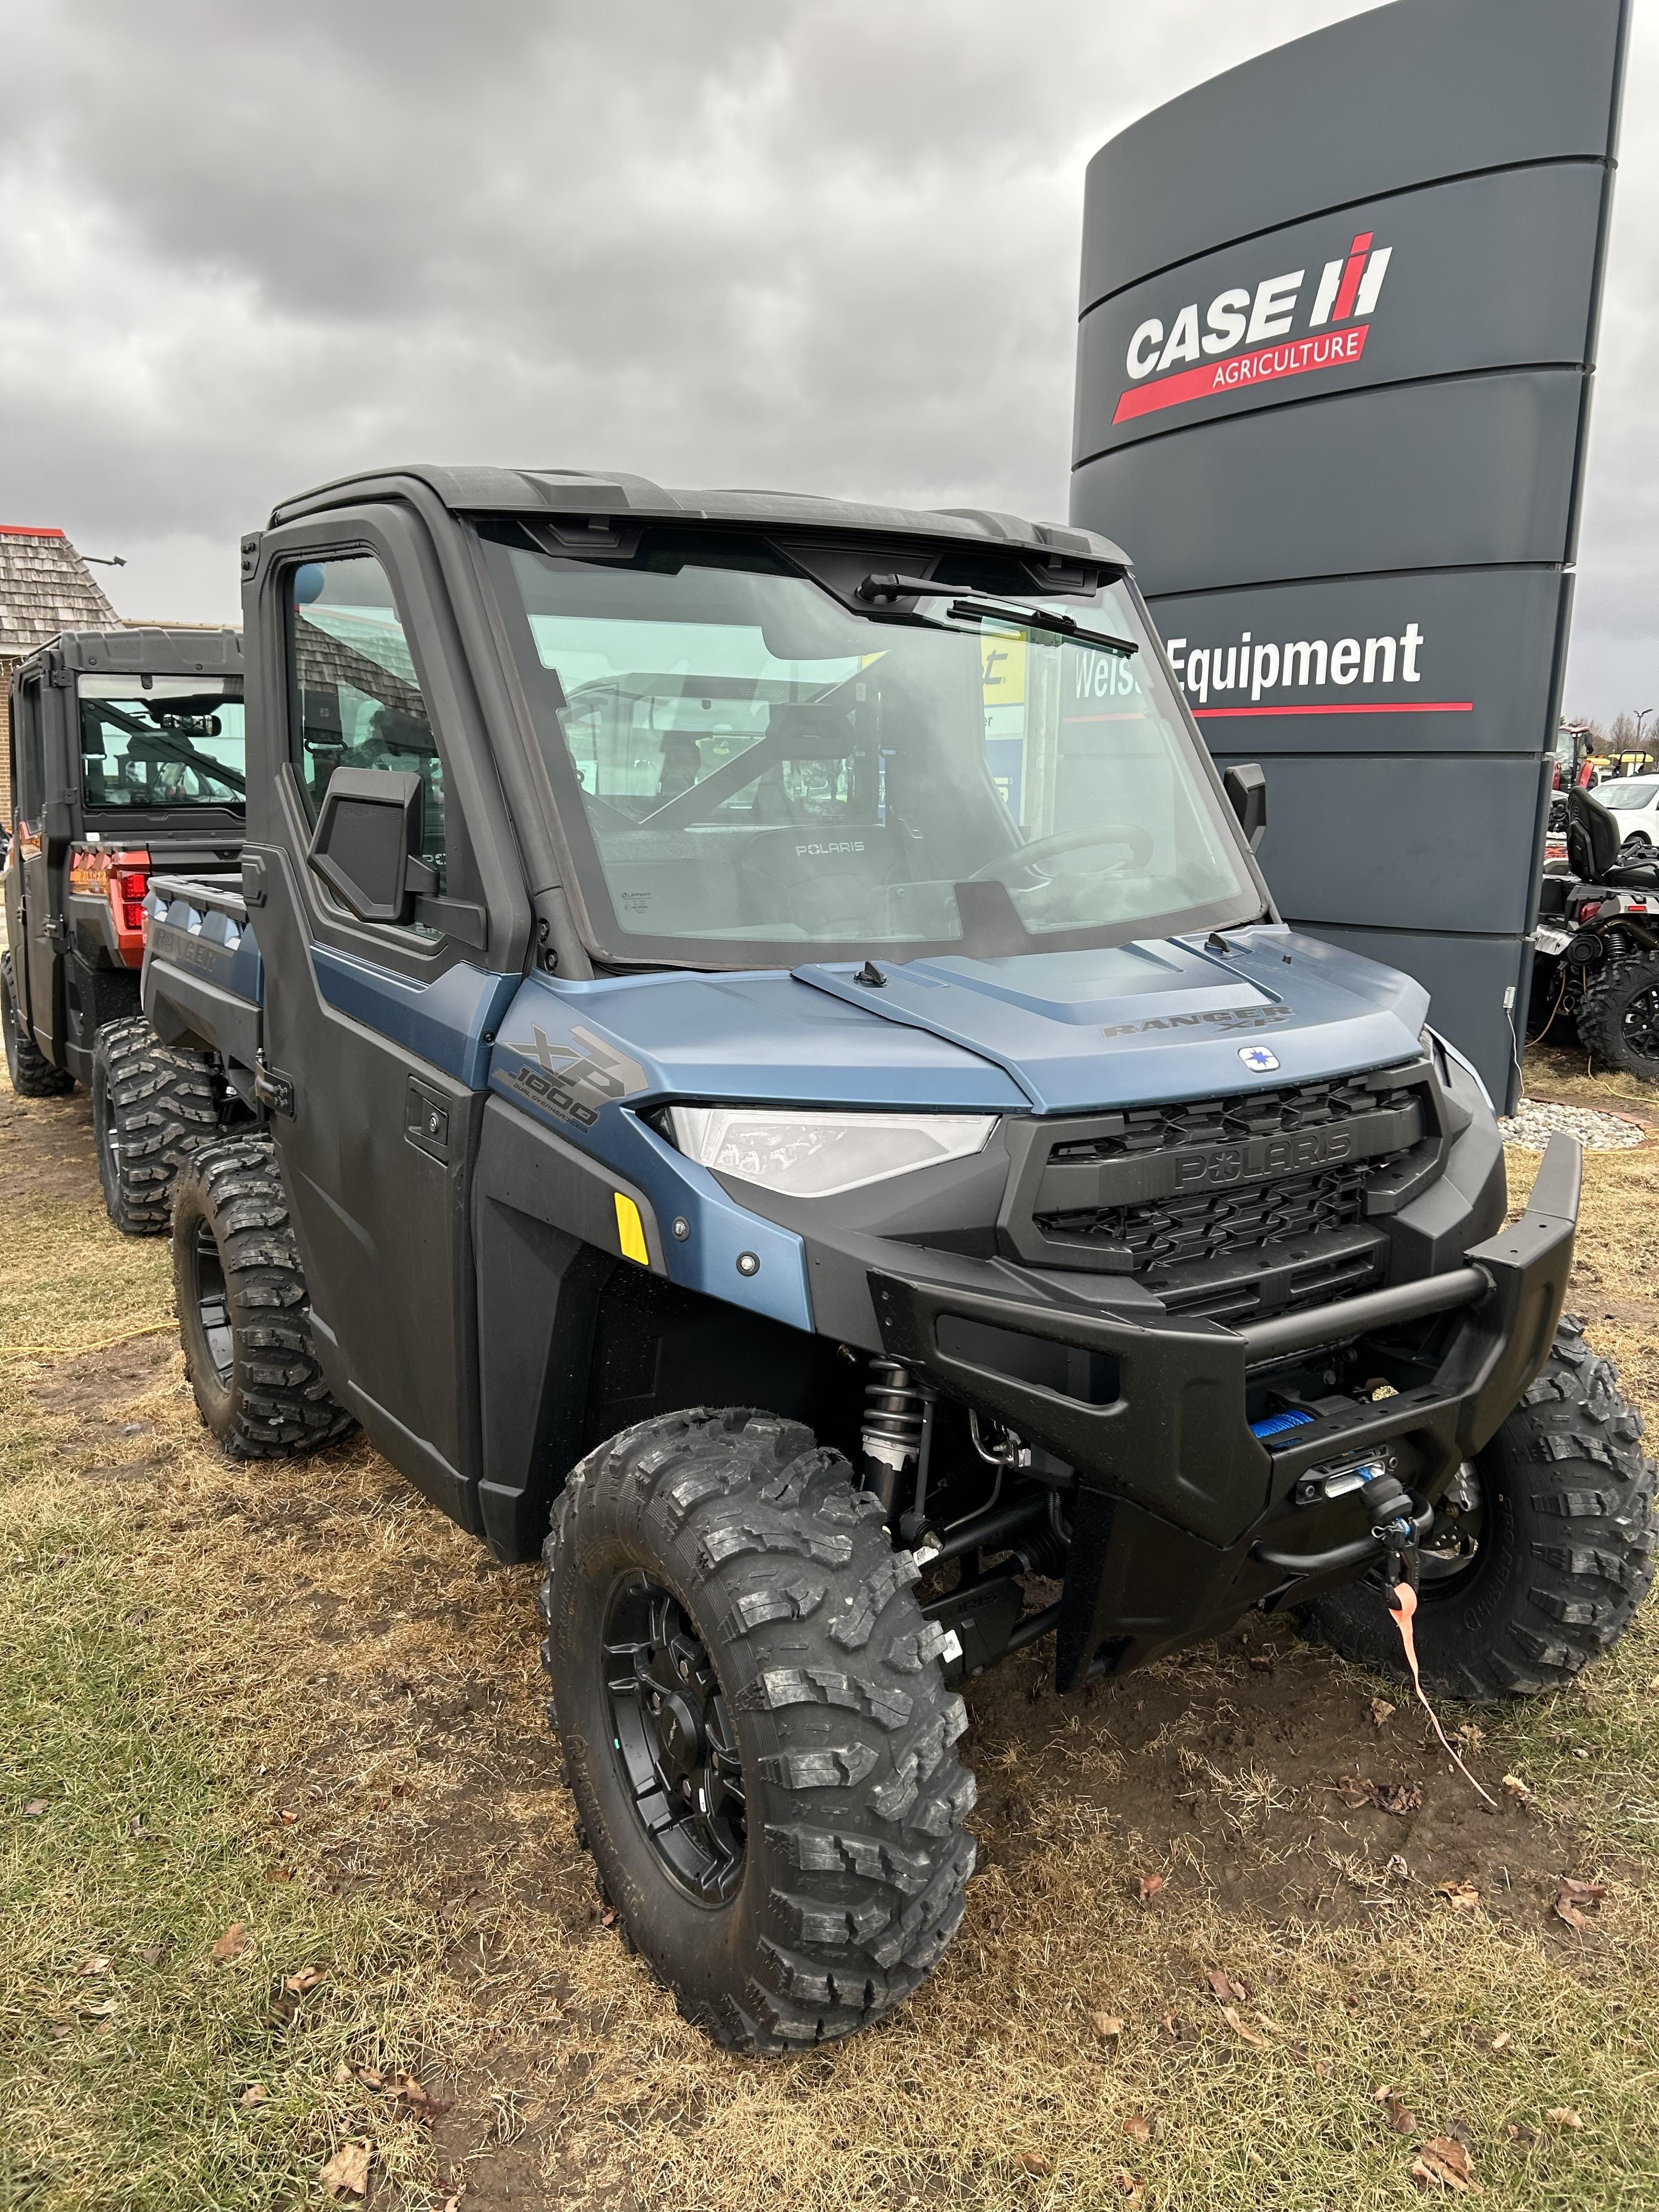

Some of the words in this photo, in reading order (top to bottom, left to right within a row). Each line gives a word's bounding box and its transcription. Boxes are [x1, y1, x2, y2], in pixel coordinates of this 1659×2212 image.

[1126, 269, 1305, 380] CASE
[1212, 332, 1359, 388] AGRICULTURE
[1075, 647, 1143, 699] Weis
[1167, 622, 1424, 703] Equipment
[795, 840, 865, 857] POLARIS
[152, 927, 217, 974] RANGER
[1101, 1005, 1296, 1039] RANGER
[1210, 1015, 1290, 1034] XP
[501, 1022, 647, 1097] XP
[510, 1066, 601, 1128] 1000
[513, 1083, 531, 1097] DUAL
[531, 1095, 571, 1121] OVERHEAD
[571, 1118, 589, 1134] CAM
[1173, 1128, 1352, 1190] POLARIS
